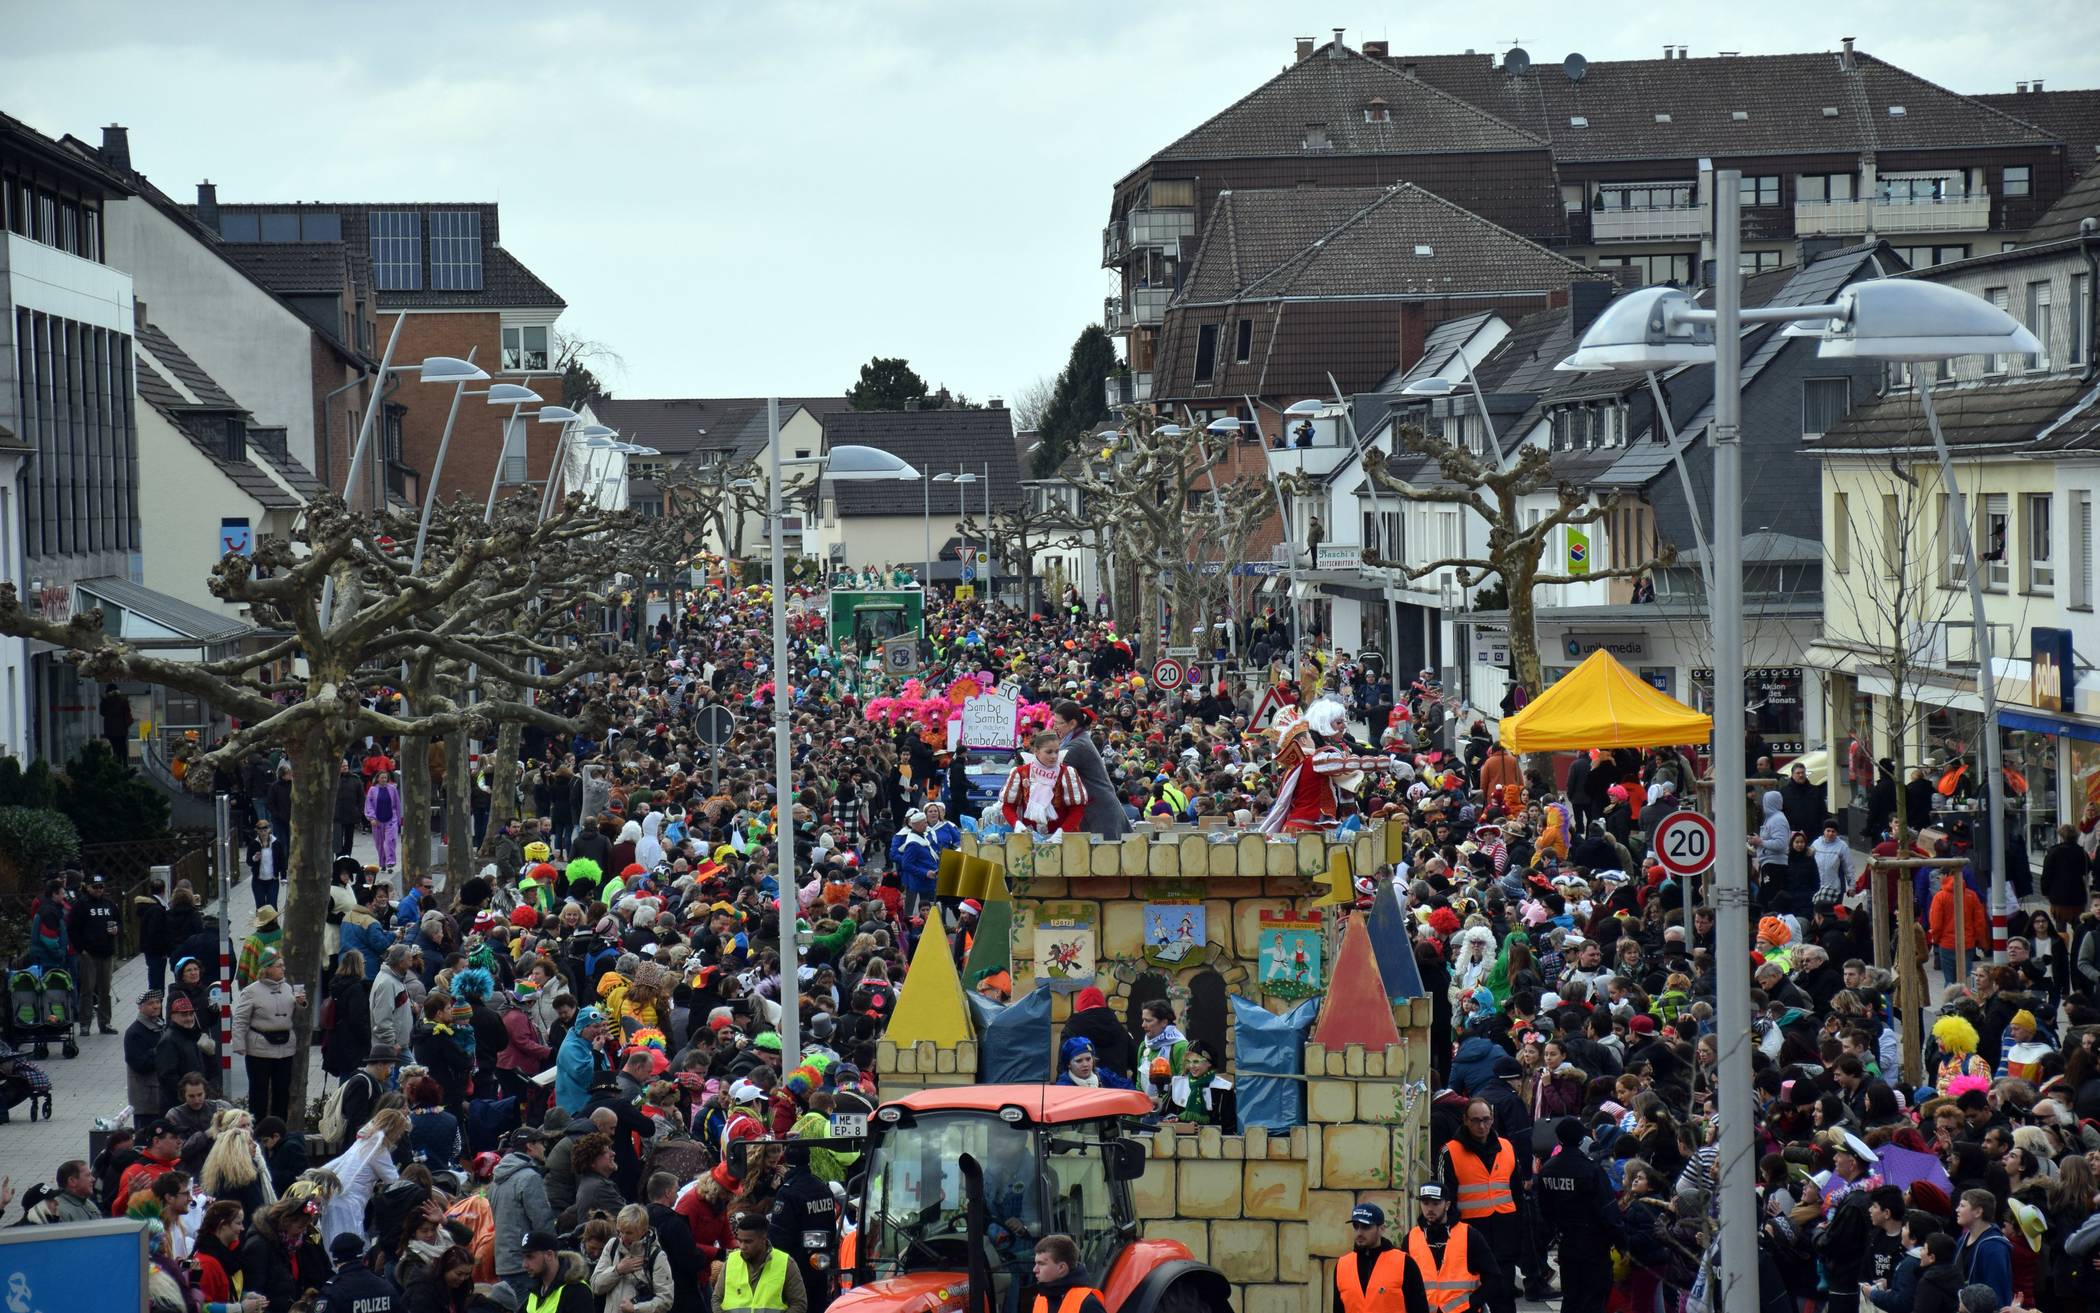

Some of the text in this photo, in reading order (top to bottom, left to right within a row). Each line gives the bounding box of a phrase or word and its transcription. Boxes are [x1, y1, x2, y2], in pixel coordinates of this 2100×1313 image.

[1160, 667, 1177, 681] 20
[2035, 652, 2061, 707] palm
[999, 683, 1019, 702] 50
[967, 698, 1001, 713] Samba
[975, 711, 1009, 725] Samba
[1670, 829, 1704, 857] 20
[90, 908, 111, 916] SEK
[839, 1115, 851, 1125] ME
[1542, 1177, 1575, 1191] POLIZEI
[806, 1198, 834, 1215] POLIZEI
[352, 1296, 391, 1313] POLIZEI
